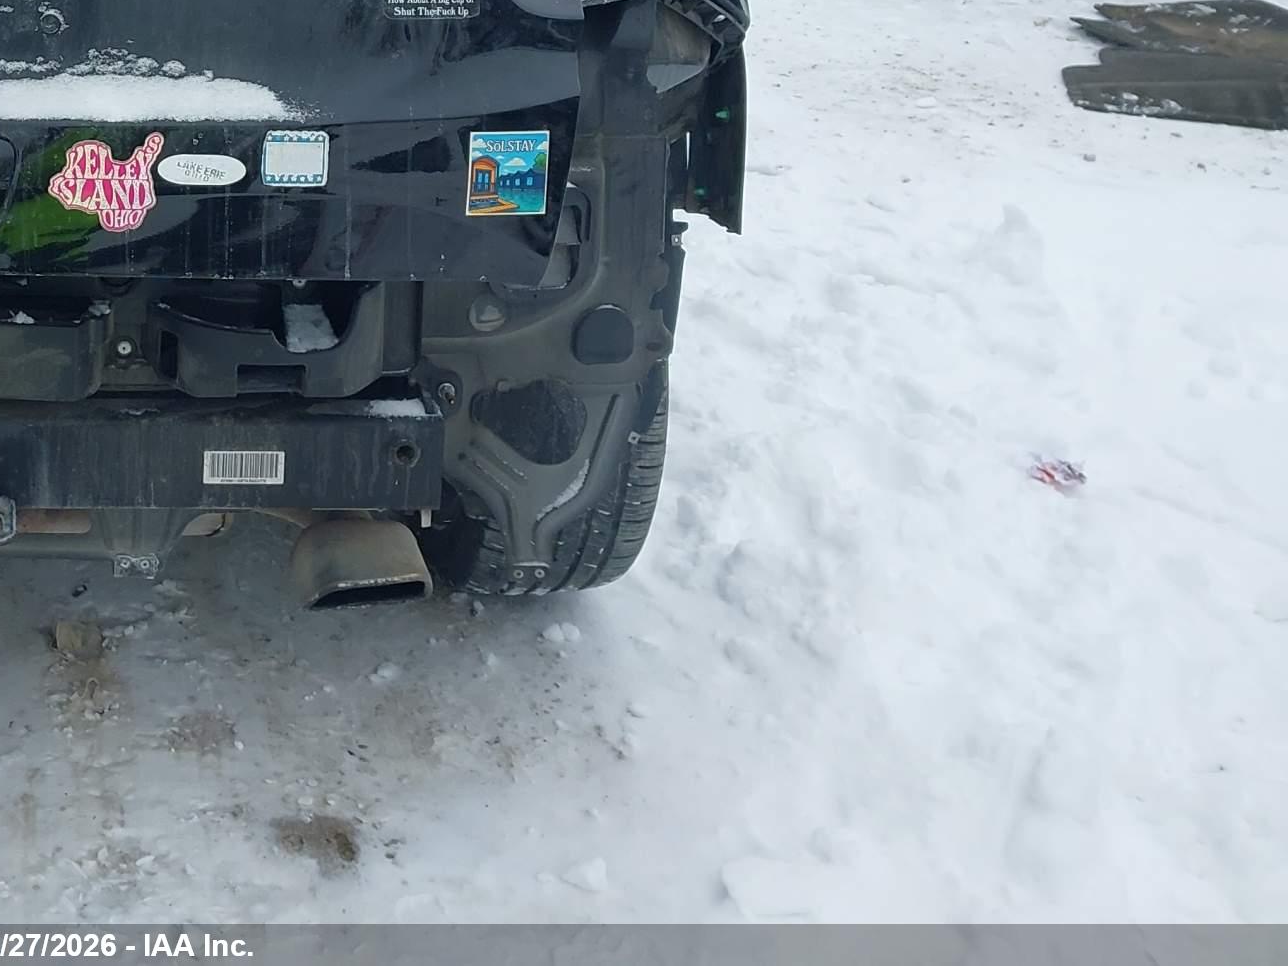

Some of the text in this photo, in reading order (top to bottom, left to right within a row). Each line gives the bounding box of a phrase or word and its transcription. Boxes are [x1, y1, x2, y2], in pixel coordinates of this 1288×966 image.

[393, 6, 469, 18] Shut The Fuck Up
[49, 179, 153, 210] ISLAND
[101, 209, 144, 228] OHIO
